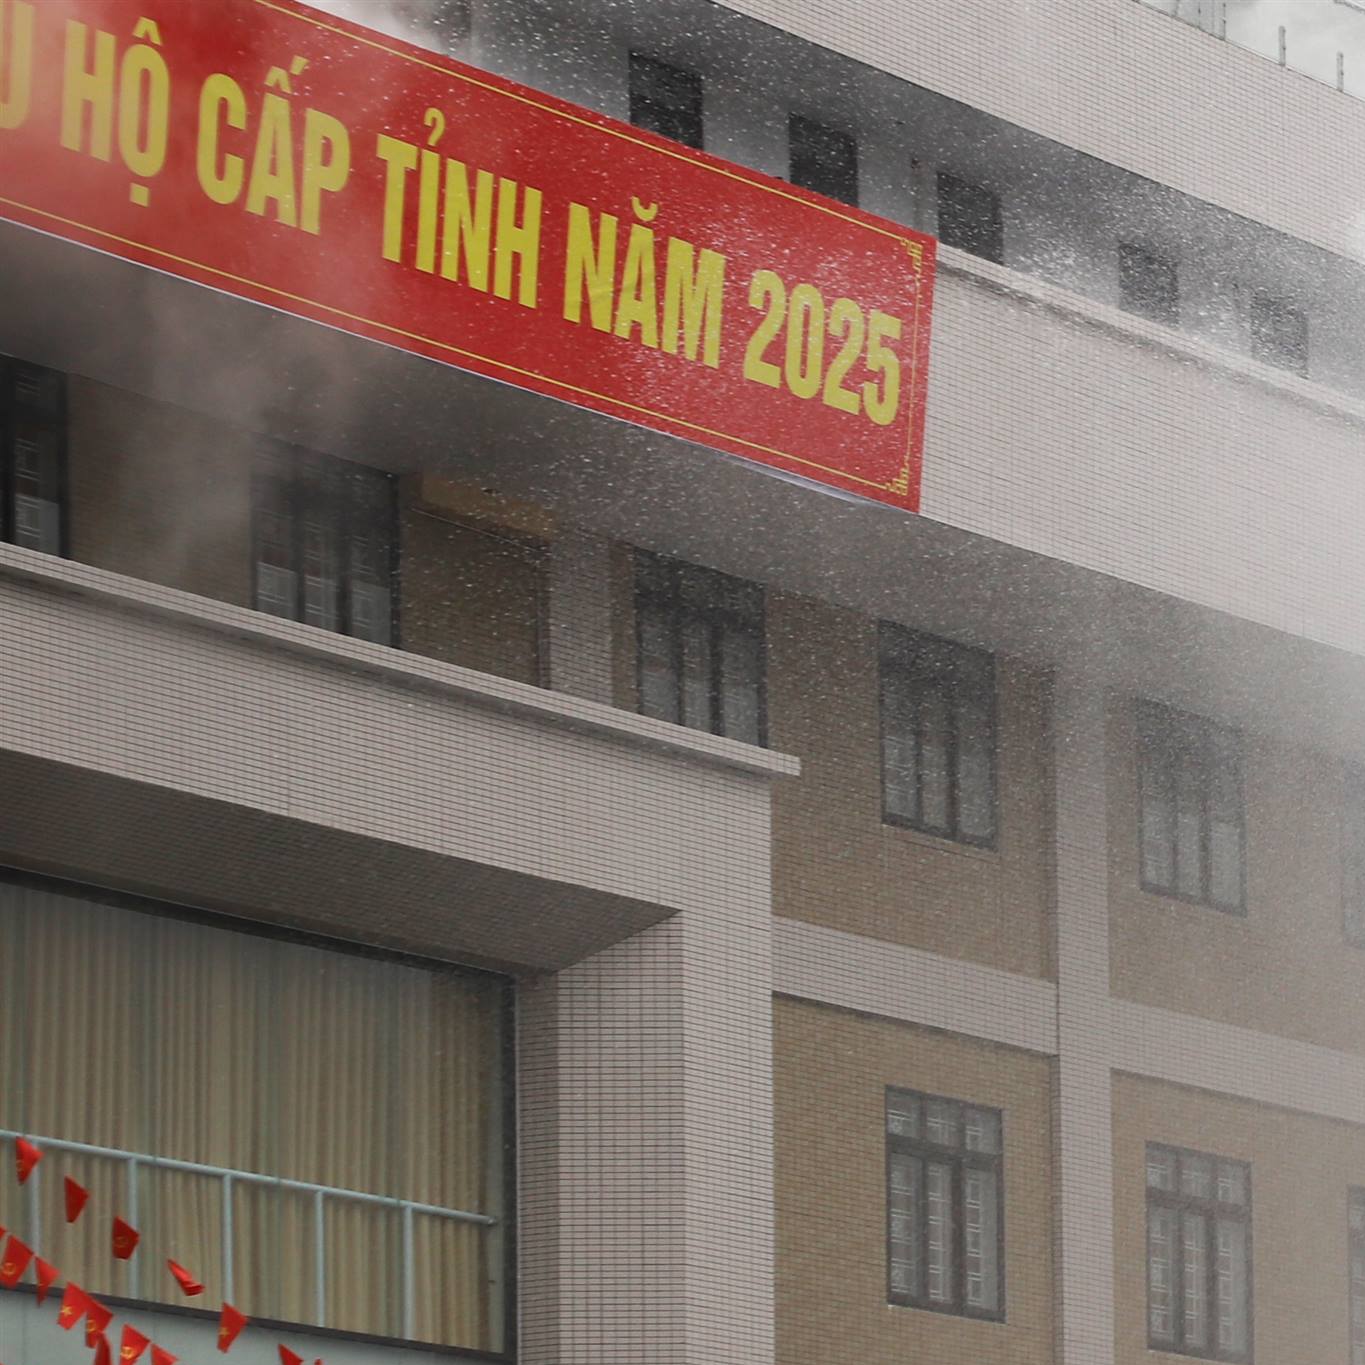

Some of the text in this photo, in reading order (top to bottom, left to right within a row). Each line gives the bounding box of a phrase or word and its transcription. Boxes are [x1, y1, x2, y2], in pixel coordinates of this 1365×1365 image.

[61, 15, 171, 207] HỘ
[197, 56, 351, 235] CẤP
[377, 107, 543, 310] TỈNH
[563, 197, 725, 369] NĂM
[743, 270, 903, 427] 2025
